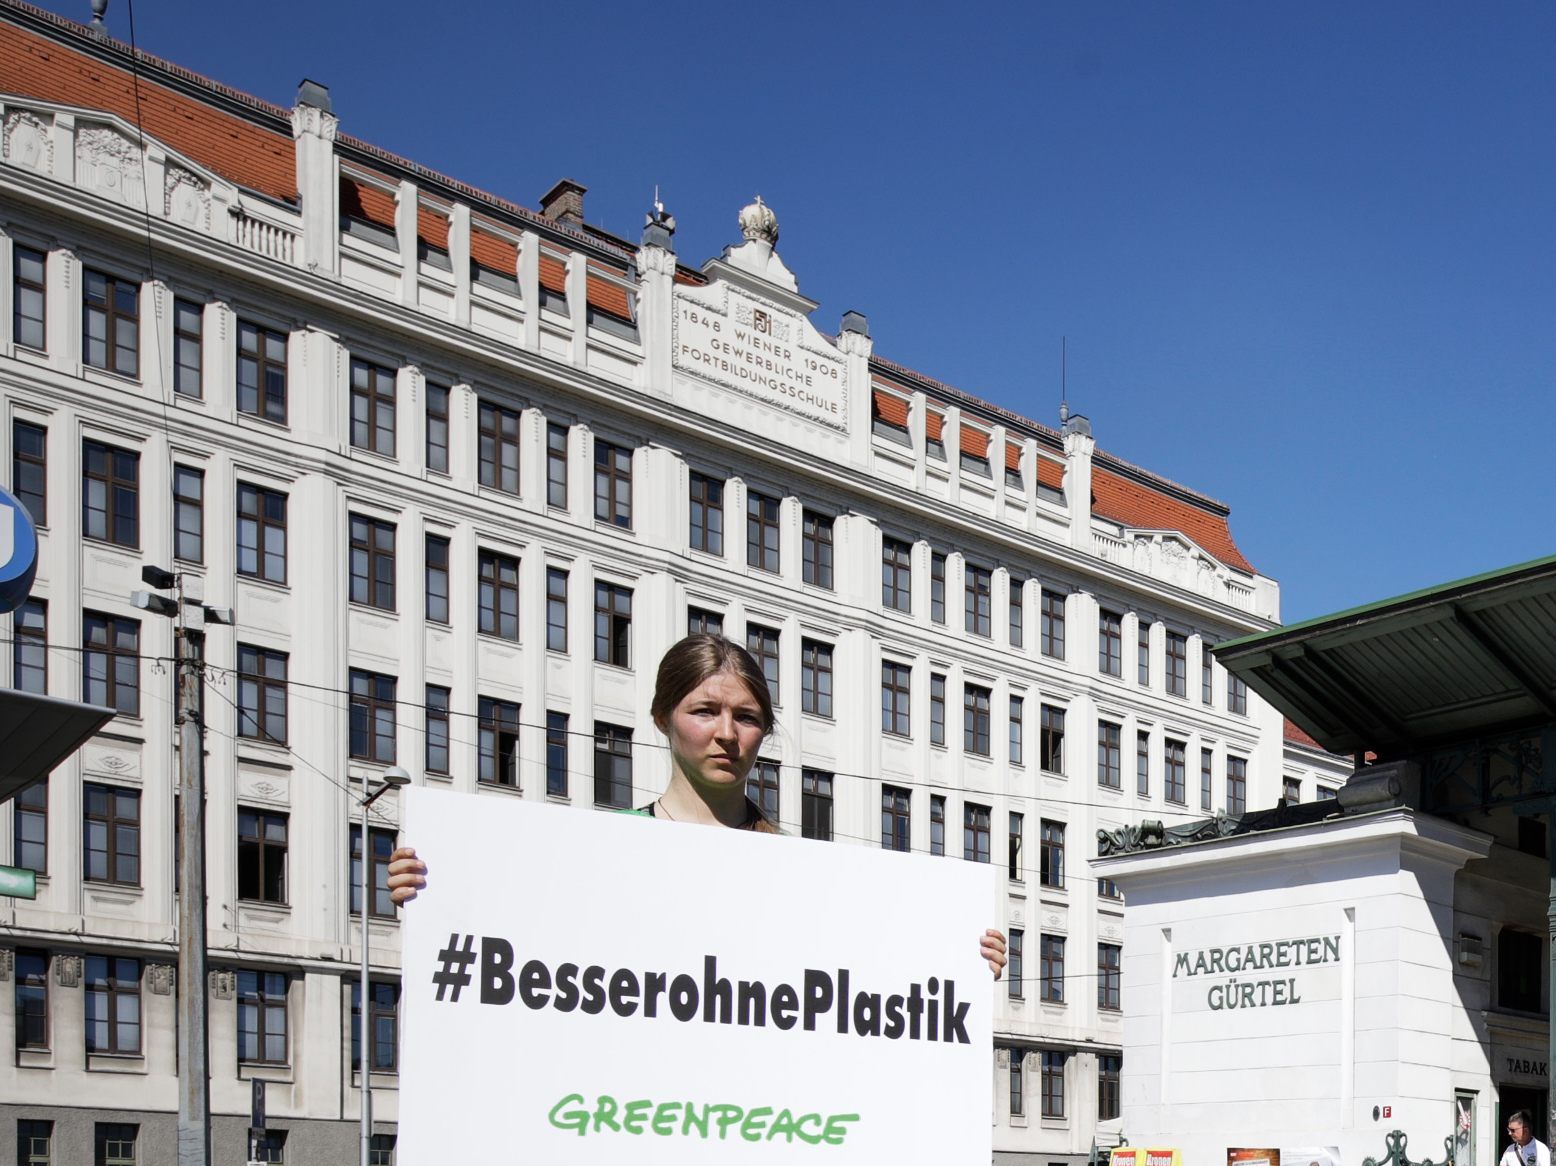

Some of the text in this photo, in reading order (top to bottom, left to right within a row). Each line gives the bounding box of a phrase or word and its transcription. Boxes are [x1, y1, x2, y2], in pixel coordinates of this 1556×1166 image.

[682, 309, 839, 380] 1848 WIENER 1908
[710, 338, 814, 387] GEWERBLICHE
[681, 344, 838, 414] FORTBILDUNGSSCHULE
[1172, 935, 1341, 978] MARGARETEN
[432, 932, 971, 1045] #BesserohnePlastik
[1207, 978, 1302, 1011] GÜRTEL
[1507, 1058, 1548, 1077] TABAK
[547, 1093, 861, 1147] GREENPEACE
[1146, 1153, 1171, 1166] Kronen
